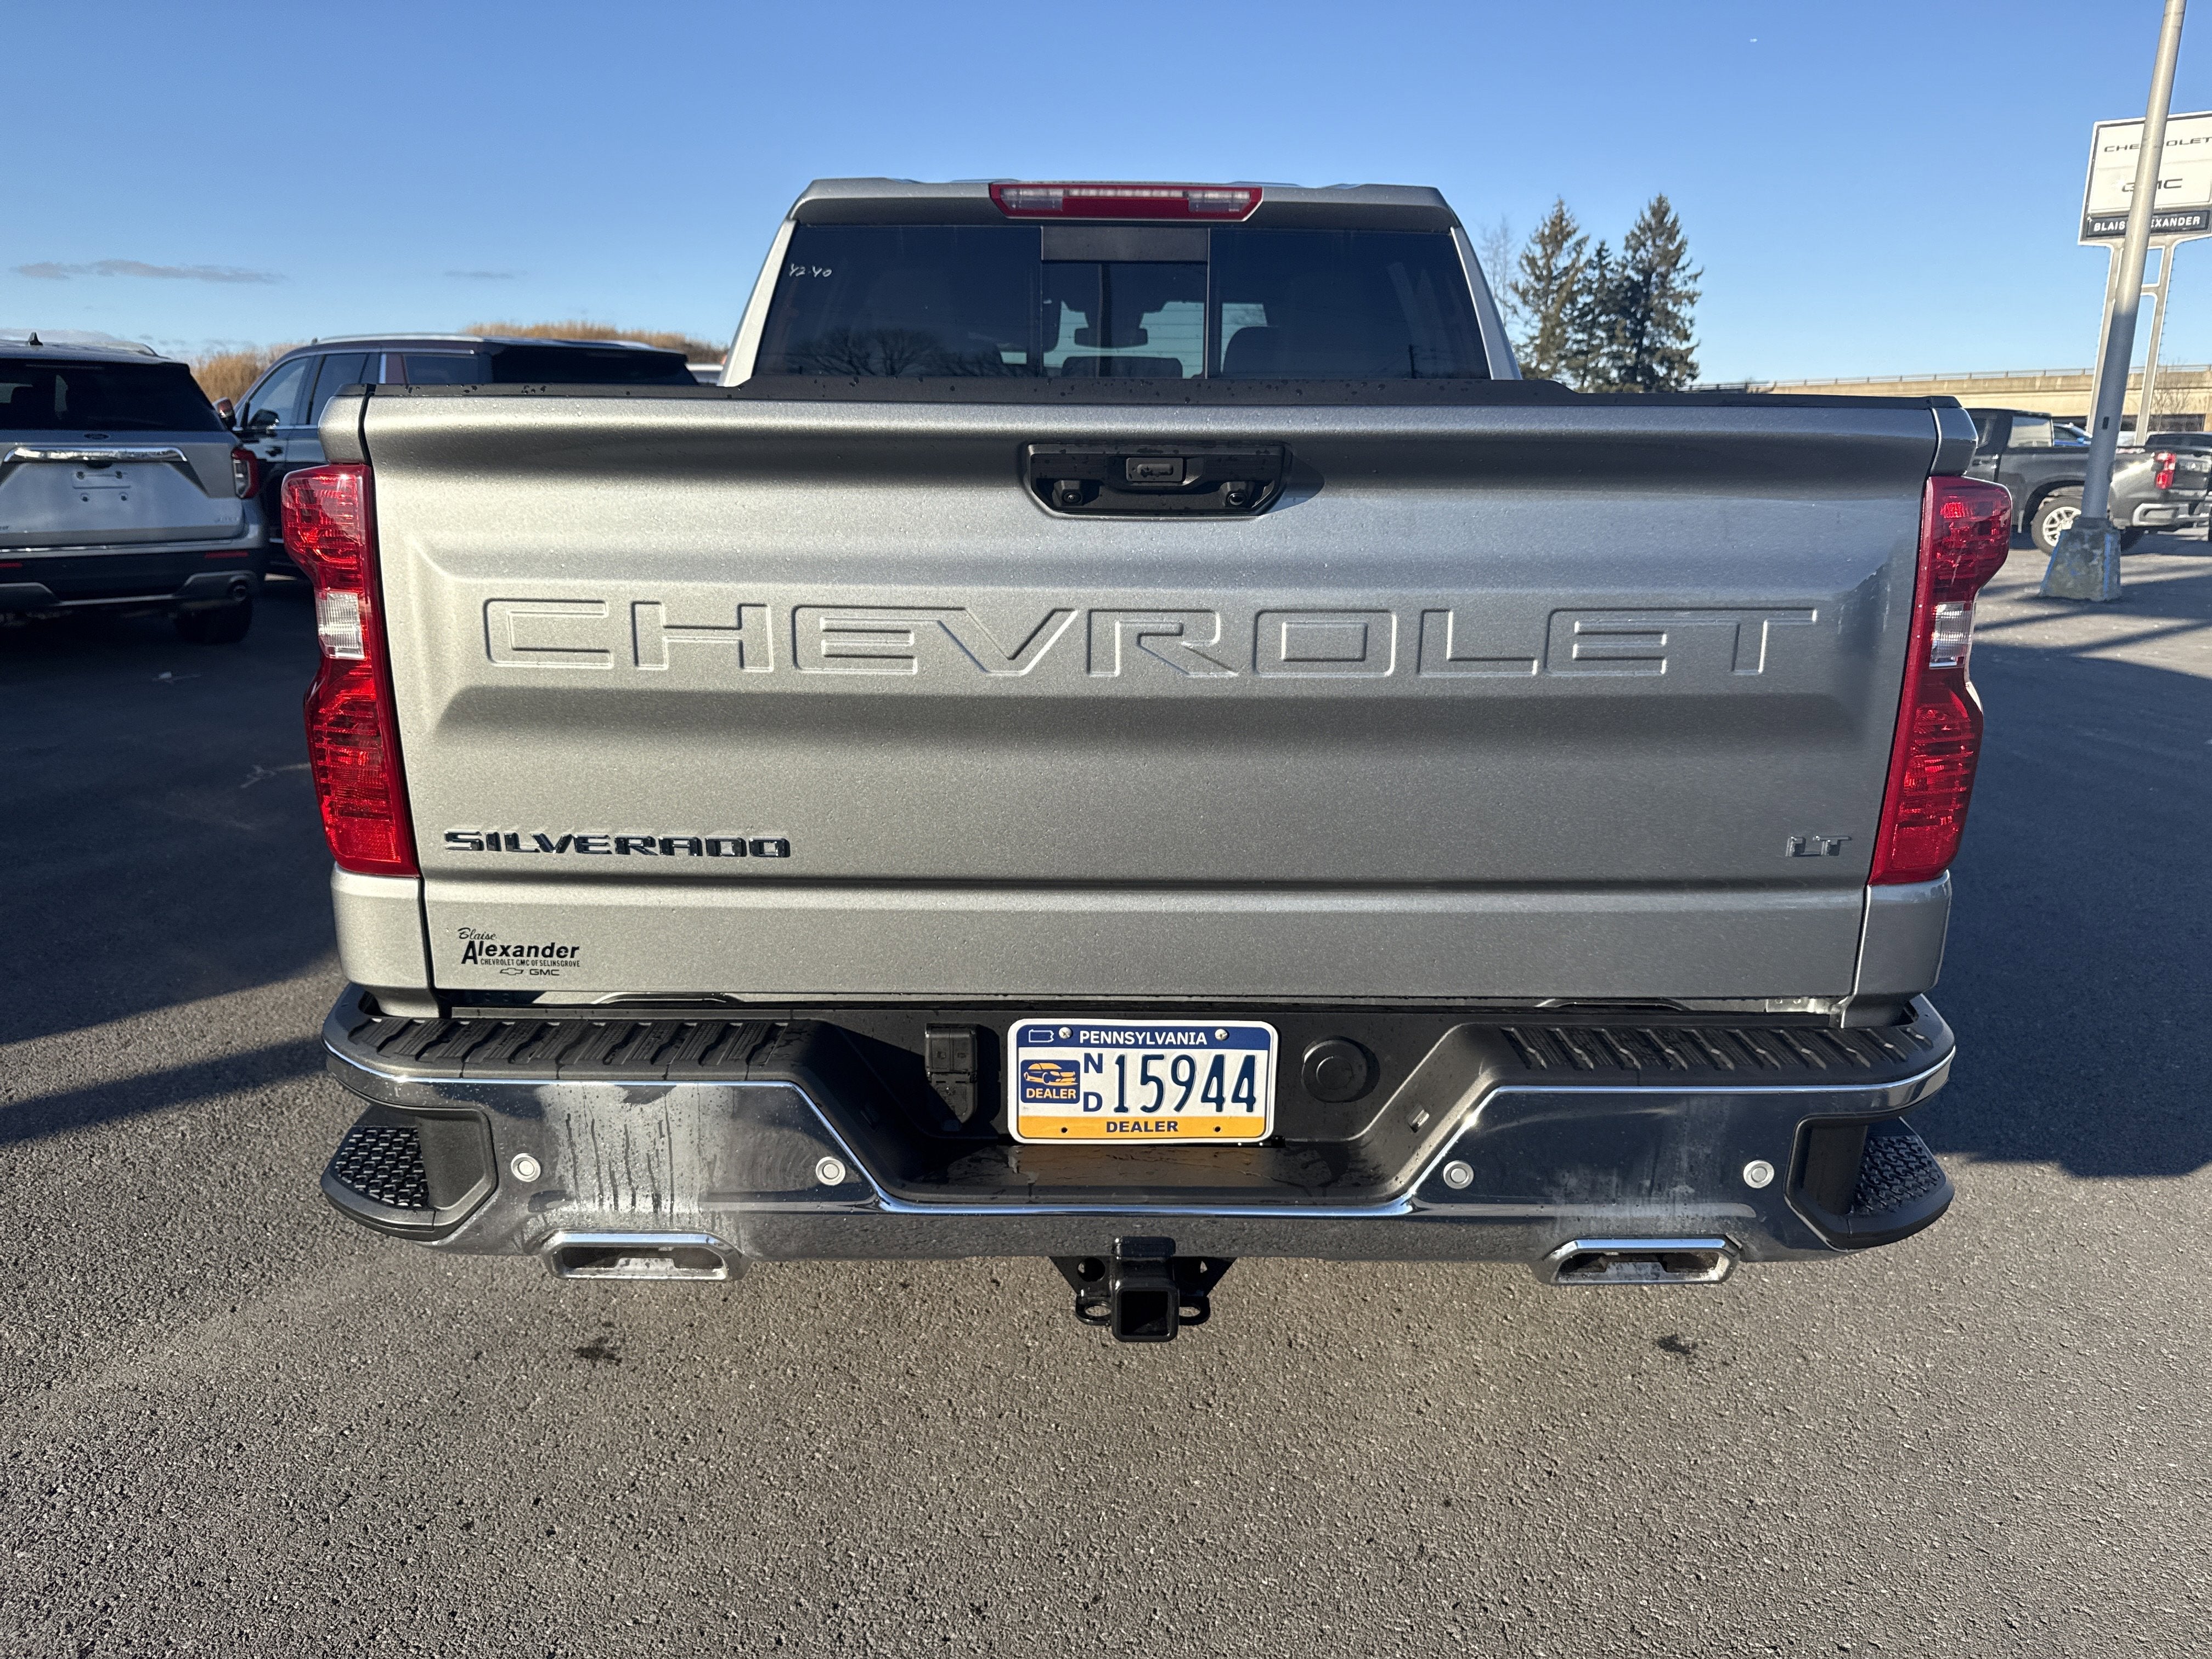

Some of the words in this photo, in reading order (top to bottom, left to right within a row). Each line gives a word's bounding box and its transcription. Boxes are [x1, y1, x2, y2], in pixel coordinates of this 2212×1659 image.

[2104, 136, 2212, 152] CHEOLET
[2094, 221, 2129, 232] BLAIS
[2150, 216, 2200, 228] XANDER
[483, 598, 1817, 678] CHEVROLET
[443, 829, 791, 857] SILVERADO
[1785, 835, 1853, 857] LT
[457, 927, 496, 940] Blaise
[461, 940, 580, 964] Alexander
[1080, 1030, 1207, 1045] PENNSYLVANIA
[1114, 1054, 1256, 1113] 15944
[1026, 1088, 1076, 1099] DEALER
[1106, 1121, 1179, 1133] DEALER
